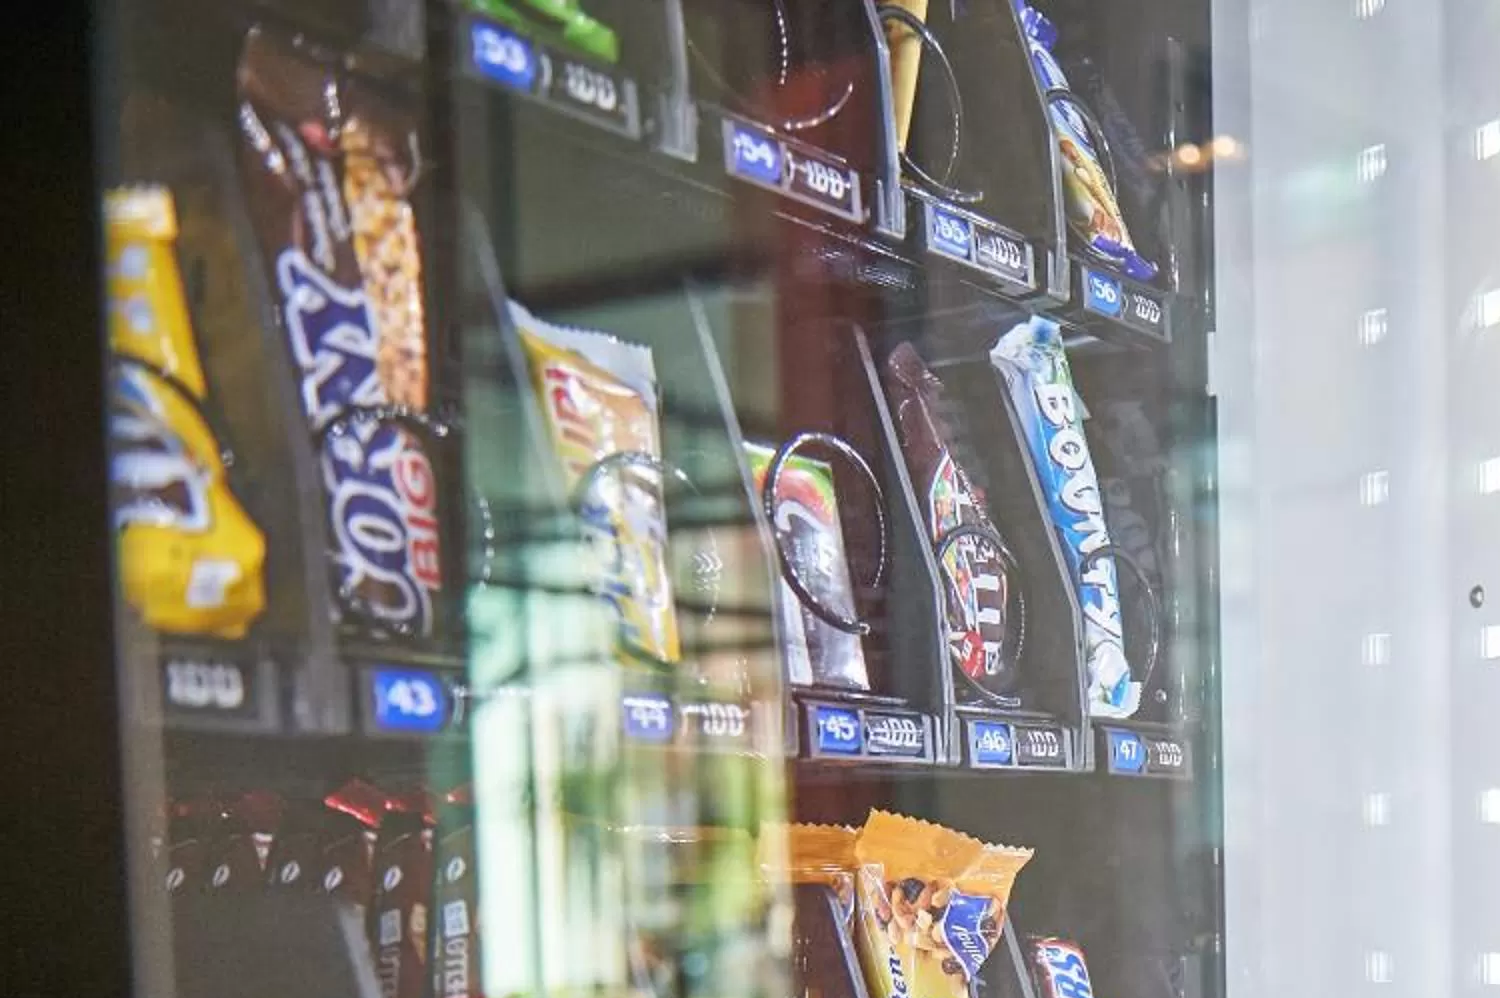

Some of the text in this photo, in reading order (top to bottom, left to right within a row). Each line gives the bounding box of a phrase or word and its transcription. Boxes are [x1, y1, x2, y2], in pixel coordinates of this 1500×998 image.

[393, 450, 442, 591] BIG
[1034, 382, 1121, 638] BOUNTY
[1119, 739, 1138, 761] 47
